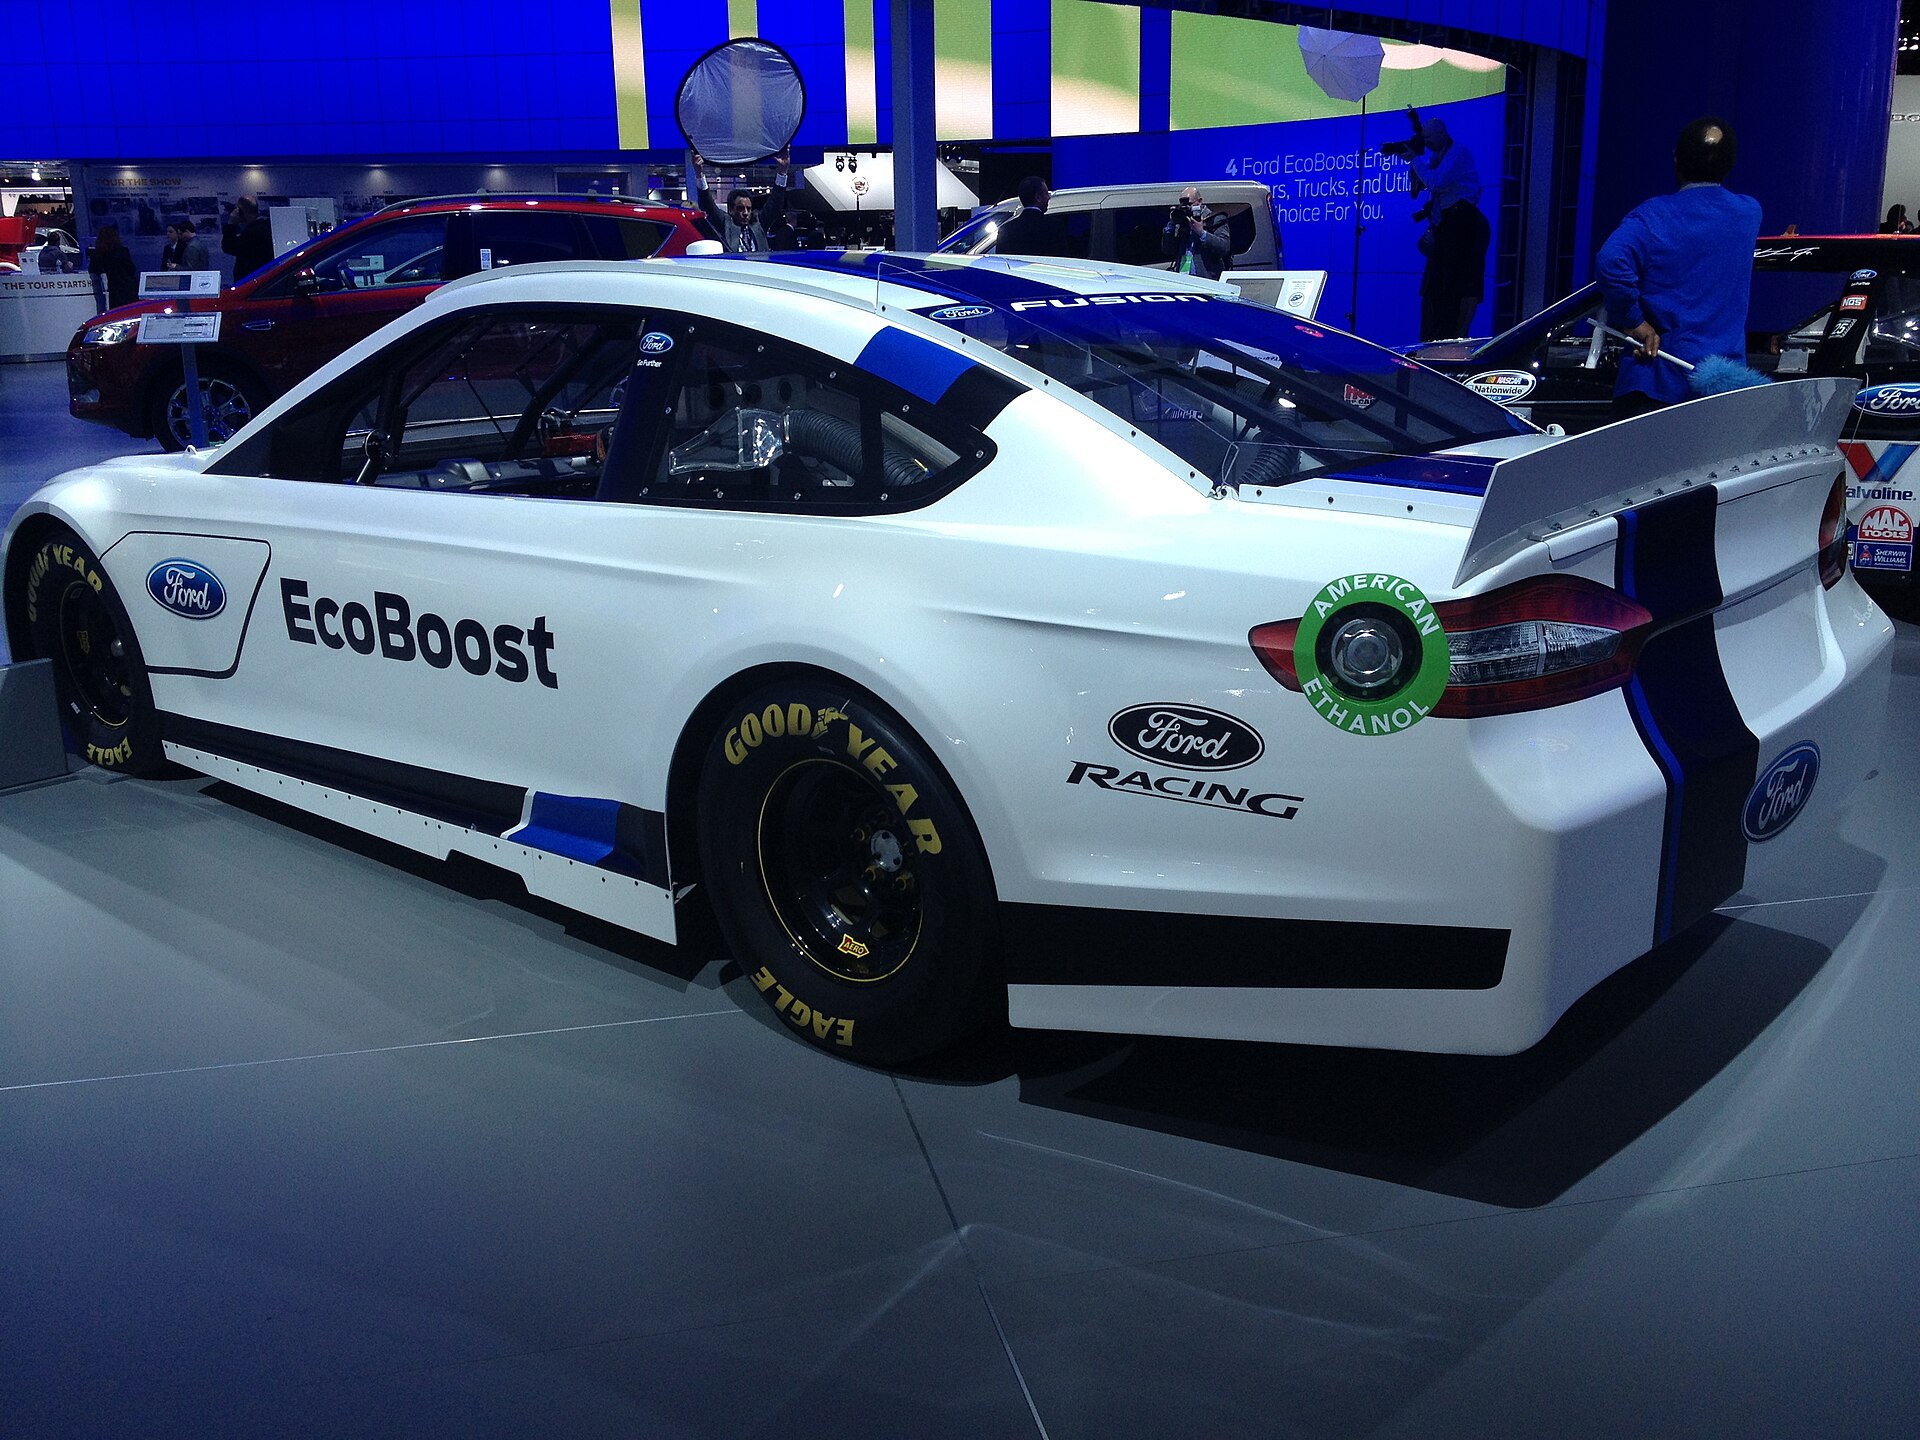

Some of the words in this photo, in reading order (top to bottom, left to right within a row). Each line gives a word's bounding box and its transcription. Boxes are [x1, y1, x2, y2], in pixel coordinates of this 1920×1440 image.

[1225, 158, 1238, 176] 4
[1242, 155, 1280, 176] Ford
[1284, 150, 1360, 174] EcoBoost
[1364, 149, 1411, 171] Engin
[126, 178, 148, 186] THE
[1272, 183, 1290, 200] rs,
[1294, 177, 1349, 198] Trucks,
[1353, 172, 1381, 194] and
[1385, 170, 1412, 193] Utili
[1275, 203, 1321, 223] hoice
[1325, 202, 1350, 221] For
[1354, 200, 1384, 220] You.
[2, 281, 25, 290] THE
[26, 281, 56, 290] TOUR
[57, 280, 87, 289] STARTS
[1010, 293, 1208, 312] FUSION
[1842, 297, 1864, 307] NOS
[1474, 385, 1523, 395] Nationwide
[1496, 376, 1522, 385] NASCAR
[1846, 486, 1917, 501] alvoline.
[1862, 509, 1910, 532] MAC
[1862, 529, 1909, 539] TOOLS
[1874, 555, 1907, 564] WILLIAMS
[1875, 548, 1907, 557] SHERWIN
[163, 566, 211, 611] Ford
[1313, 574, 1440, 637] AMERICAN
[279, 576, 559, 690] EcoBoost
[1303, 676, 1430, 734] ETHANOL
[1137, 710, 1232, 760] Ford
[86, 736, 133, 767] EAGLE
[1066, 759, 1305, 820] RACING
[1757, 758, 1809, 831] Ford
[843, 941, 865, 954] AERO
[750, 965, 855, 1047] EAGLE
